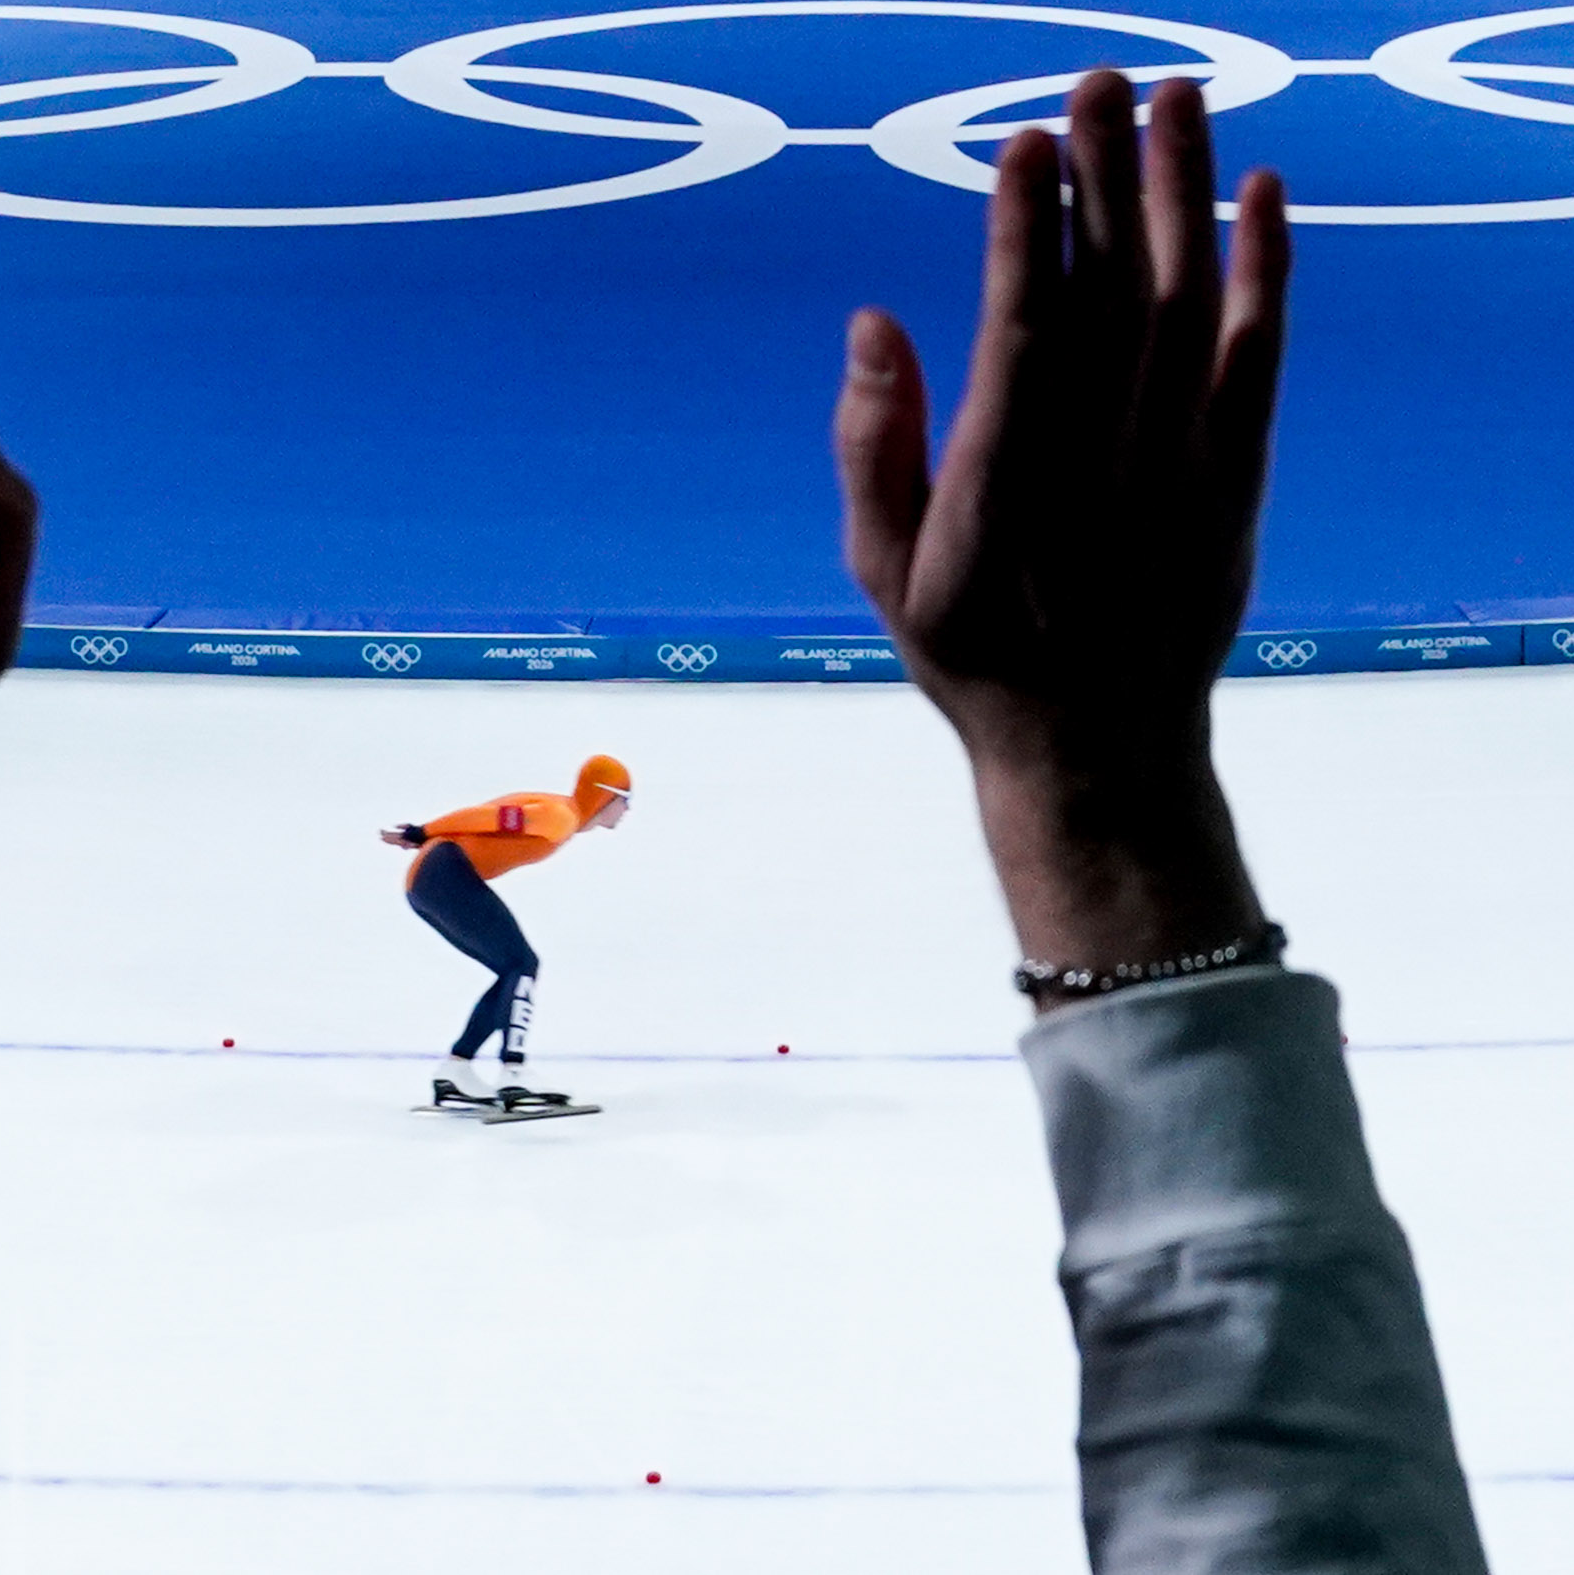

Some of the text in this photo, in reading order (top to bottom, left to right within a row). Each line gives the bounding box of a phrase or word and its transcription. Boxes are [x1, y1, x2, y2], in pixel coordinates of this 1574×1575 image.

[188, 643, 301, 656] MILANO CORTINA
[482, 647, 598, 659] MILANO CORTINA
